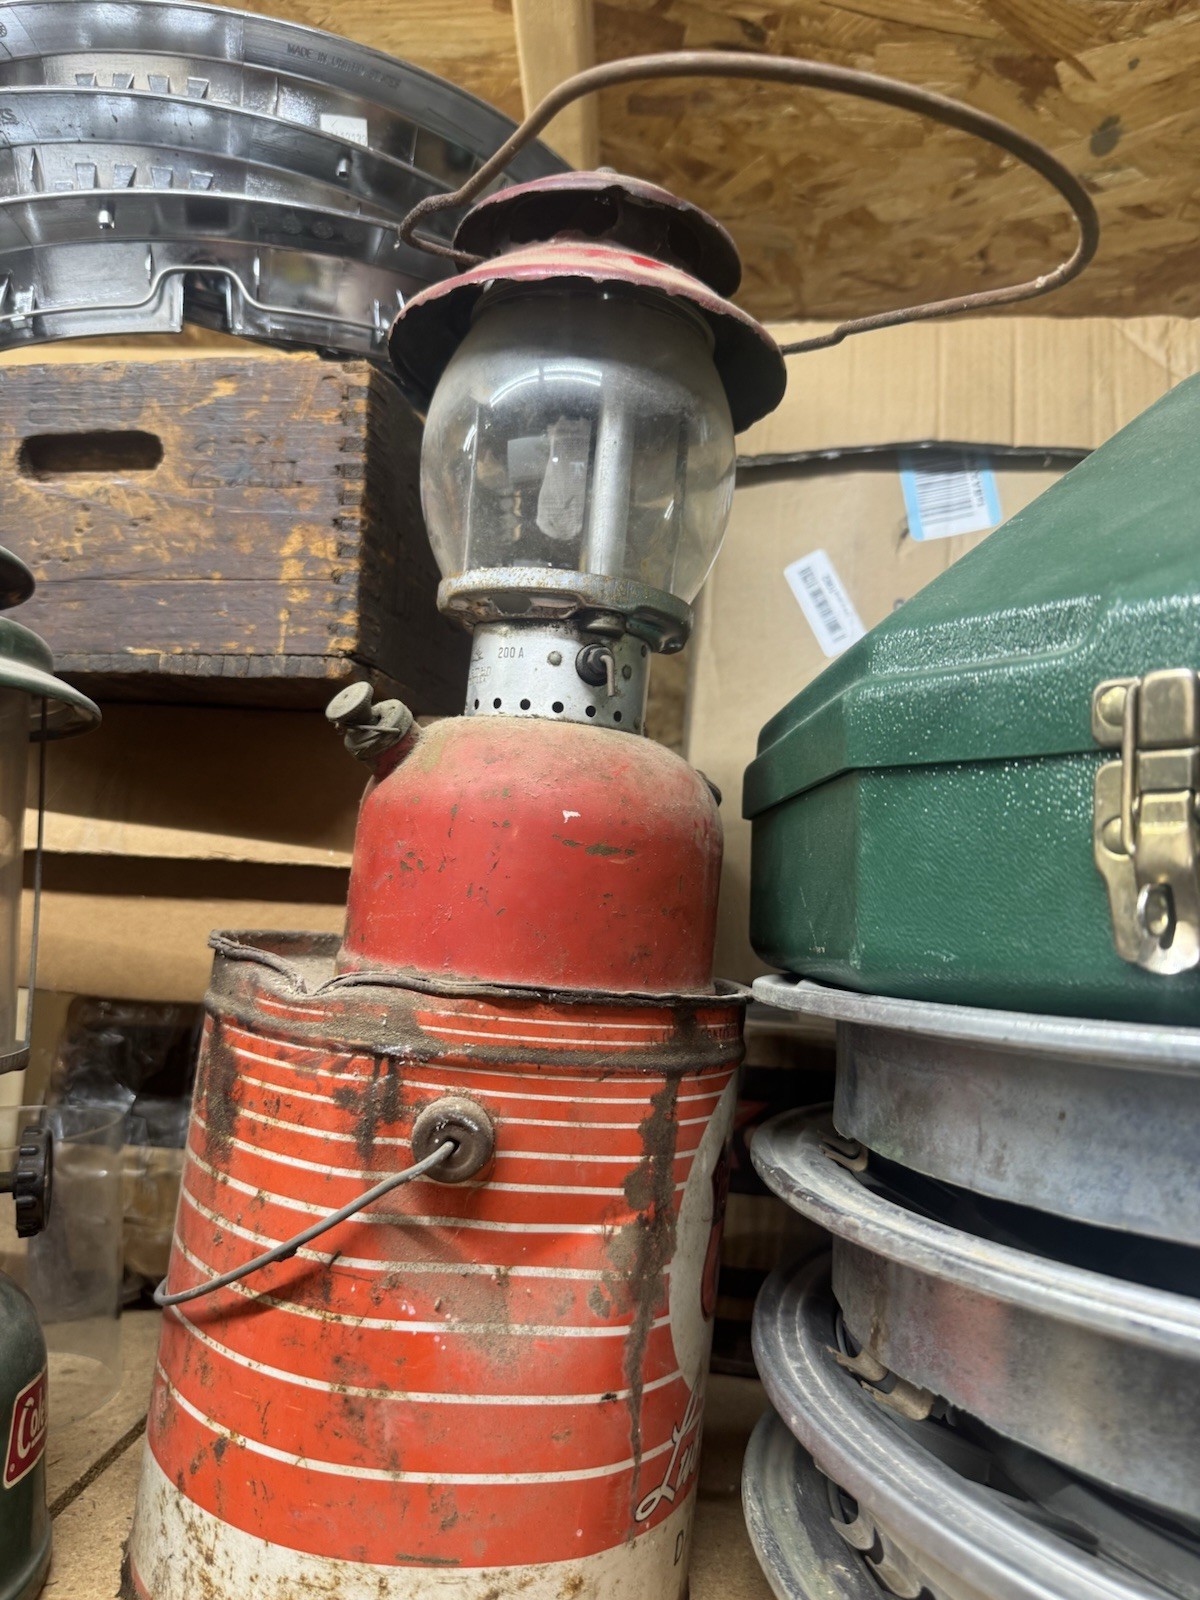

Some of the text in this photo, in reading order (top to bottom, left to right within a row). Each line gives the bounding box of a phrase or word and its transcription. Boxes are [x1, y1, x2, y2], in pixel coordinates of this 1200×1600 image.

[287, 44, 314, 59] MADE
[317, 51, 328, 64] IN
[498, 646, 524, 658] 200 A
